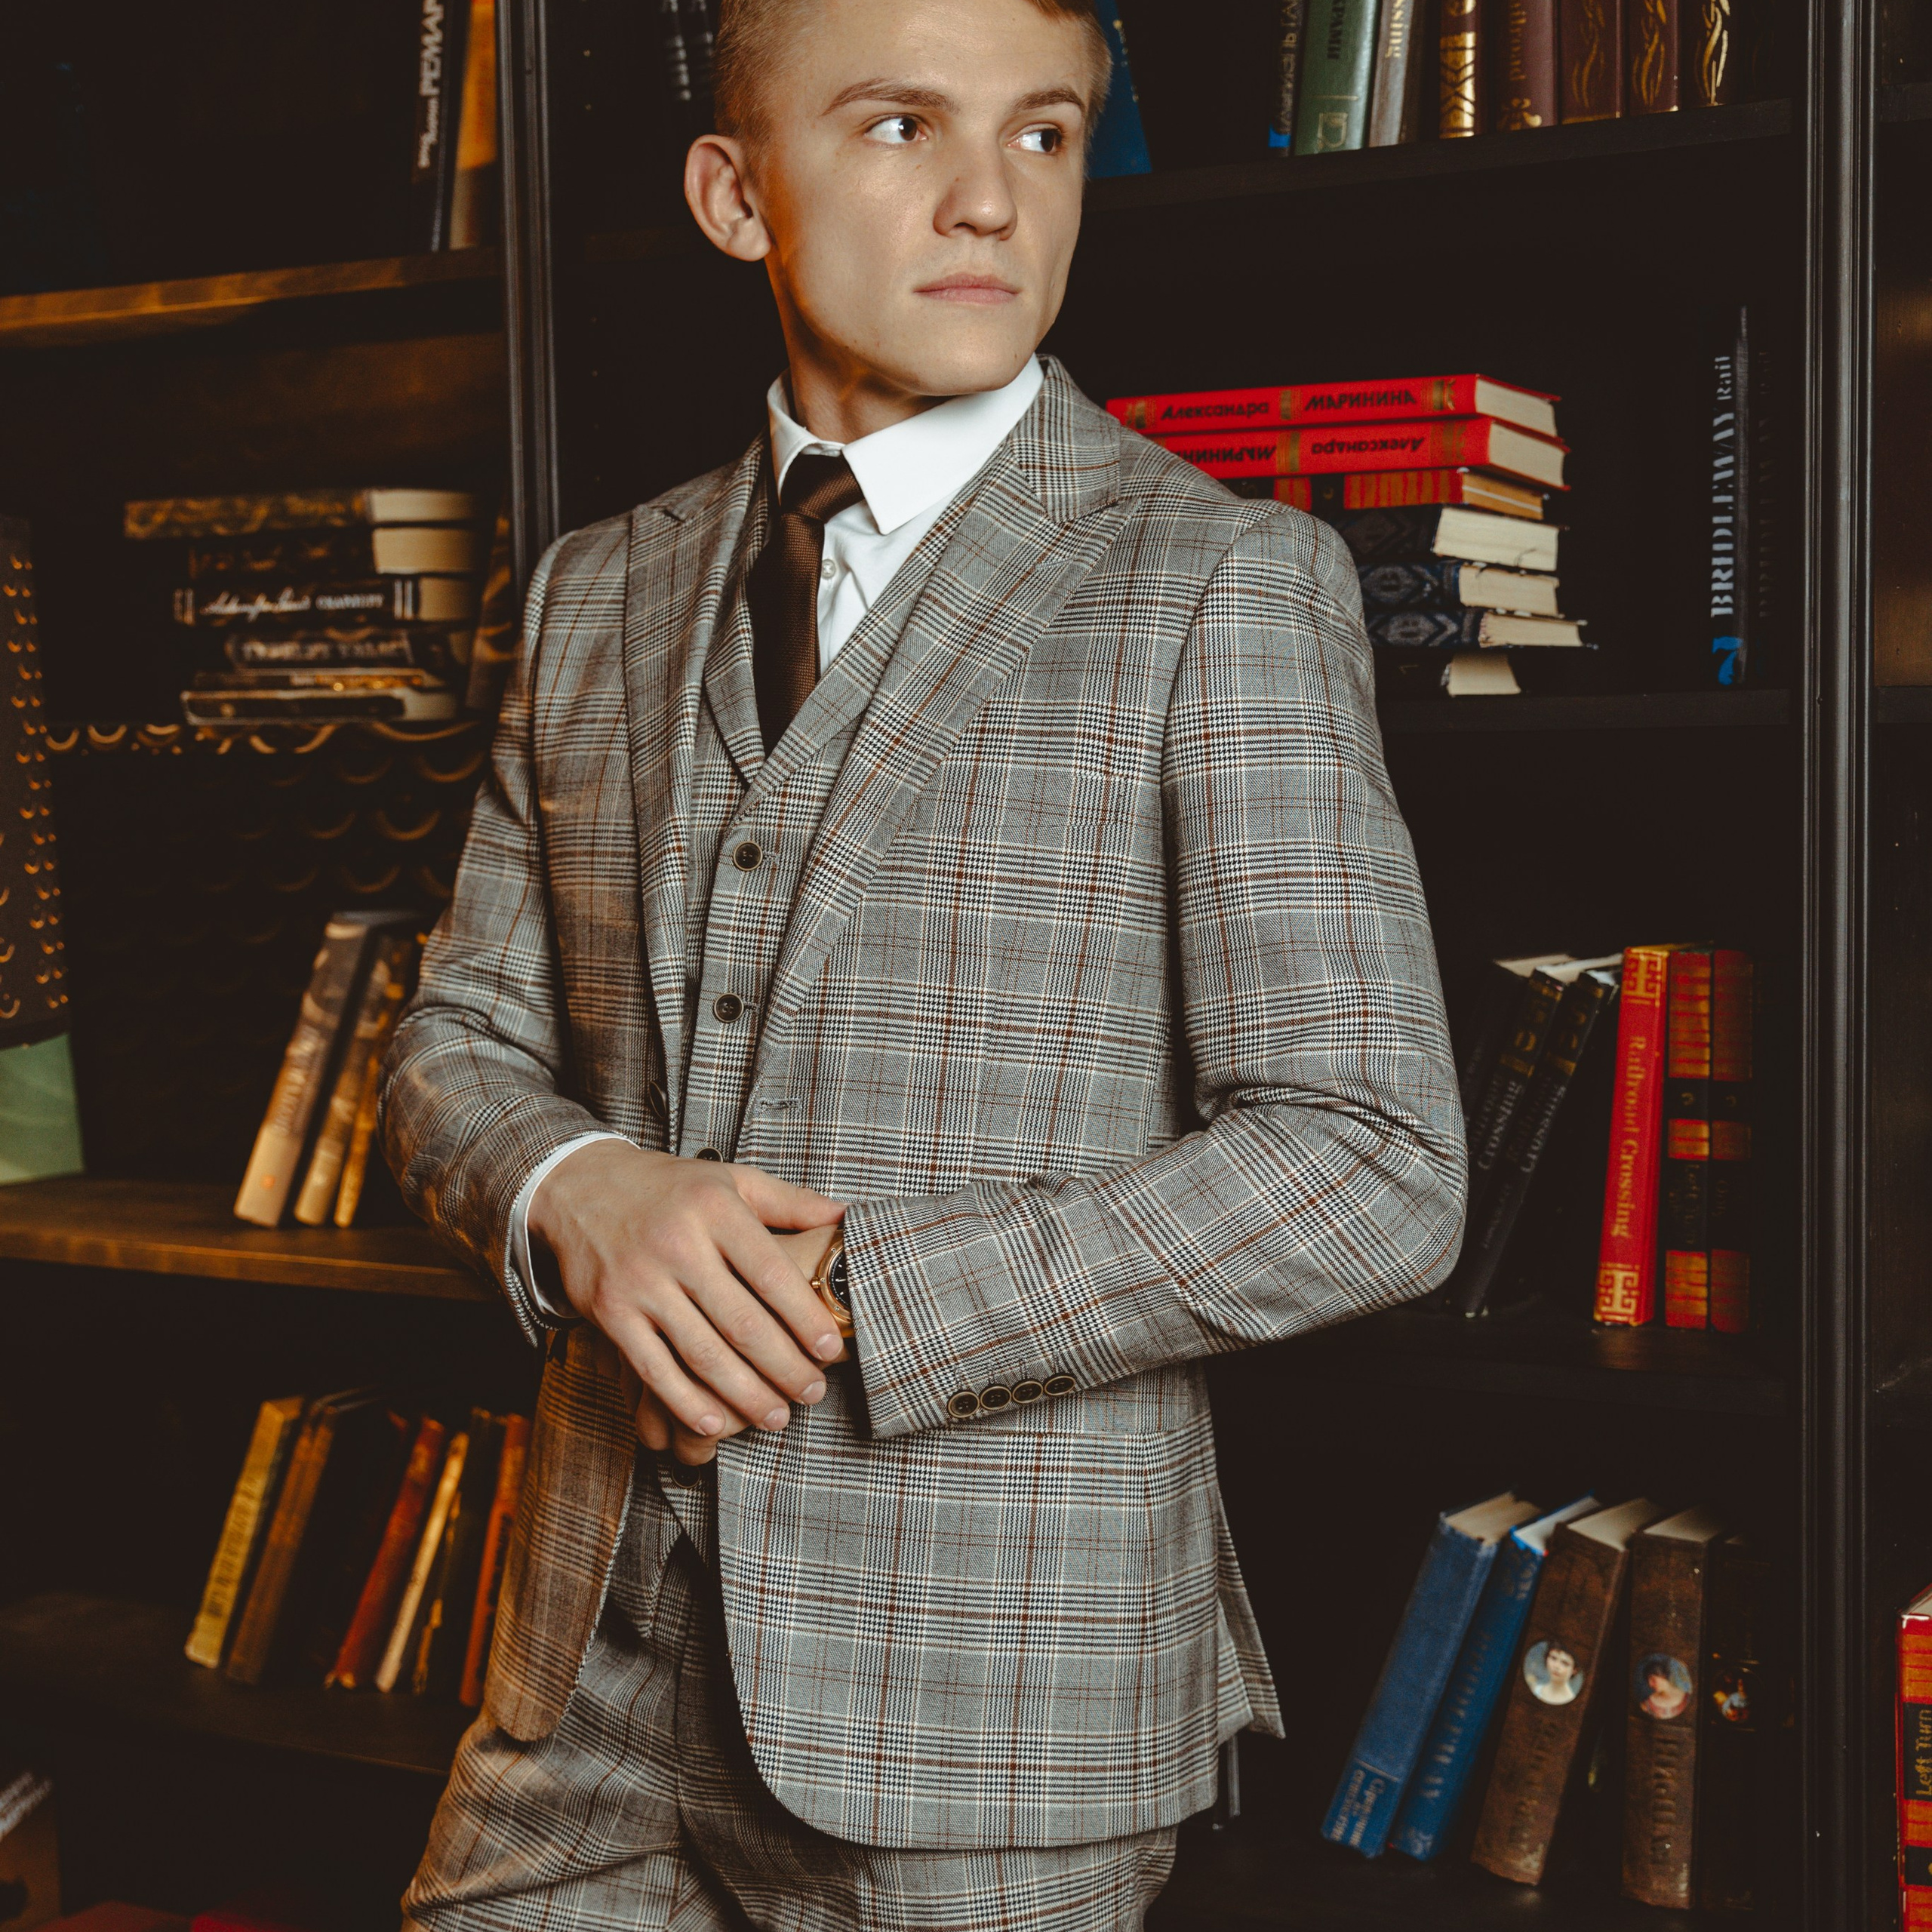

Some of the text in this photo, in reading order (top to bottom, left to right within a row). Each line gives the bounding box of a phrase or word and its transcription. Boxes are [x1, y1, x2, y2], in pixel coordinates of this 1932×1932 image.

[1160, 387, 1417, 420] Александра МАРИНИНА
[1179, 436, 1426, 464] Александра МАРИНИН
[1710, 355, 1736, 620] BRIDLEWAY Rail
[1711, 635, 1743, 687] 7
[1477, 1079, 1524, 1171] Crossing
[1611, 1035, 1647, 1238] Railroad Crossing
[1914, 1709, 1932, 1796] Left Turn
